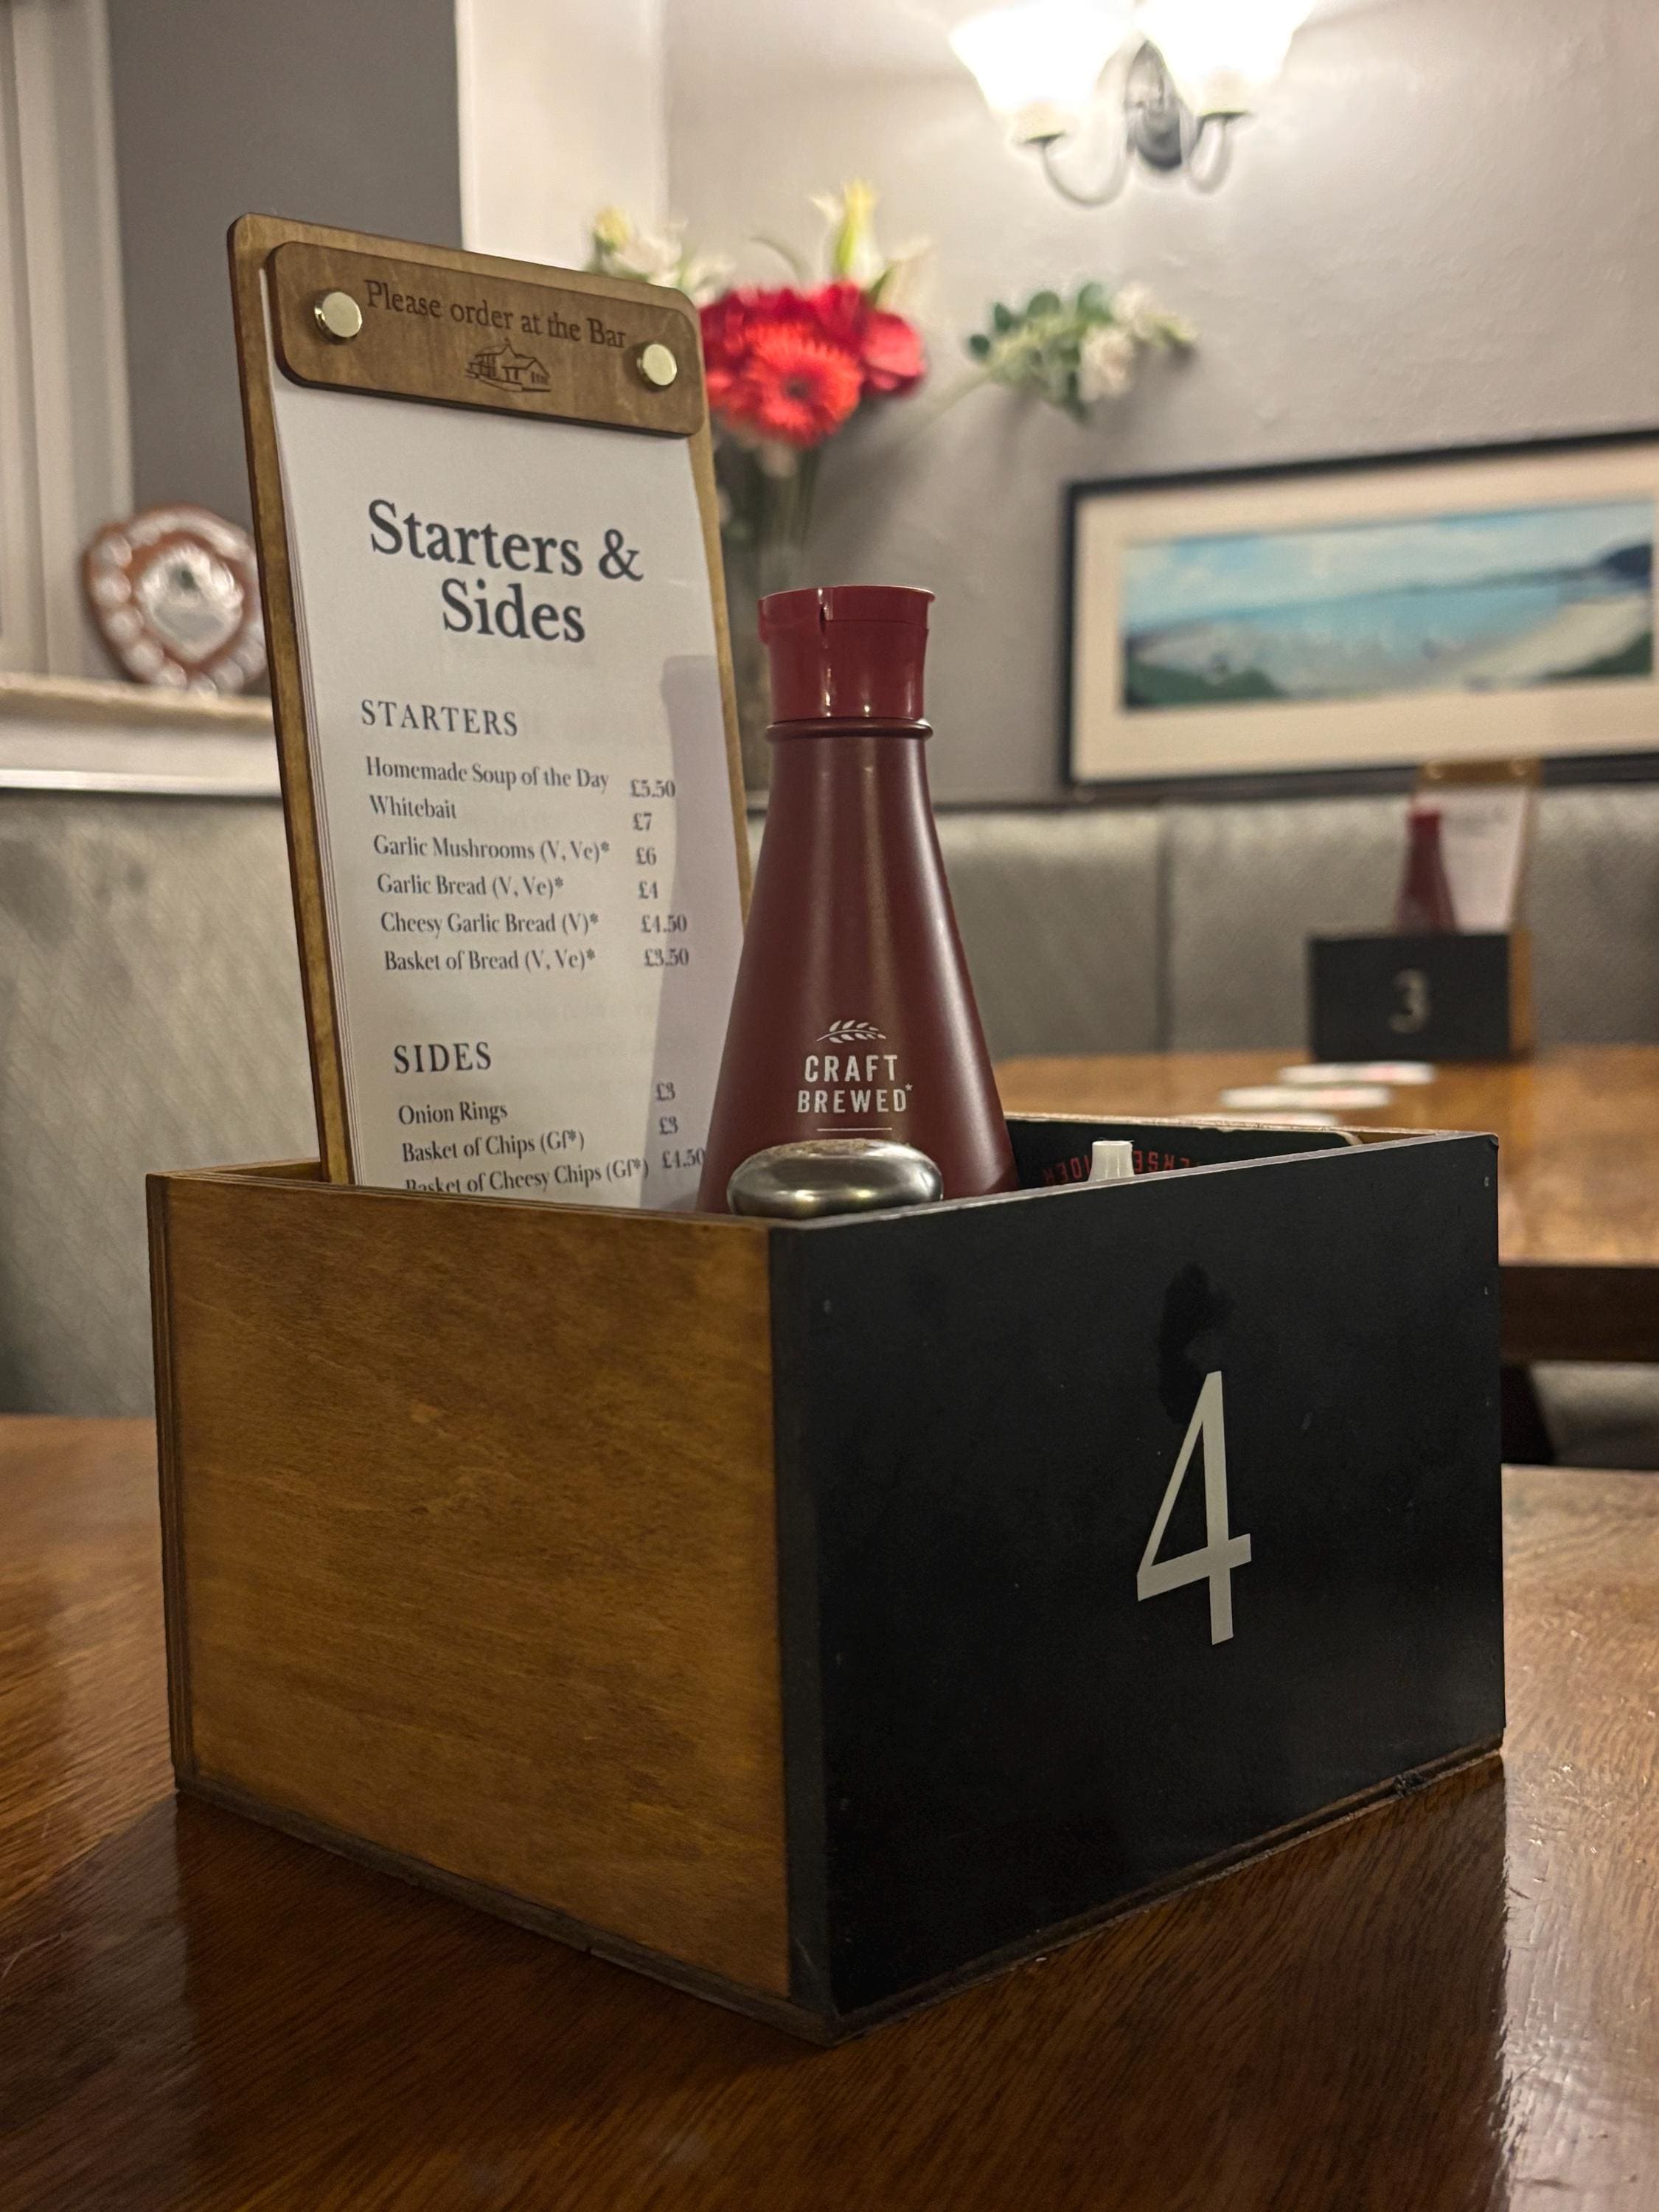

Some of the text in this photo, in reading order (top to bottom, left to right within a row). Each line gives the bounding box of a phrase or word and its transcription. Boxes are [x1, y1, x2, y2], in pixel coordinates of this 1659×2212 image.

[364, 279, 626, 349] Please order at the Bar
[368, 498, 644, 582] Starters &
[442, 577, 586, 644] Sides
[361, 699, 518, 737] STARTERS
[366, 756, 675, 798] Homemade Soup of the Day £5.50
[369, 795, 653, 832] Whitebait £7
[373, 835, 428, 857] Garlic
[433, 836, 535, 860] Mushrooms
[636, 846, 656, 866] £6
[377, 873, 431, 895] Garlic
[437, 875, 486, 896] Bread
[380, 911, 442, 939] Cheesy
[447, 912, 501, 933] Garlic
[505, 912, 556, 933] Bread
[384, 950, 440, 972] Basket
[446, 950, 467, 970] of
[469, 950, 519, 970] Bread
[644, 948, 689, 967] £3.50
[1388, 970, 1430, 1034] 3
[394, 1041, 492, 1074] SIDES
[804, 1054, 897, 1082] CRAFT
[398, 1082, 675, 1125] Onion Rings £3
[402, 1141, 458, 1162] Basket
[463, 1136, 482, 1157] of
[486, 1134, 535, 1159] Chips
[659, 1116, 678, 1135] £3
[467, 1172, 486, 1192] of
[490, 1168, 550, 1192] Cheesy
[554, 1164, 602, 1188] Chips
[1137, 1370, 1251, 1645] 4
